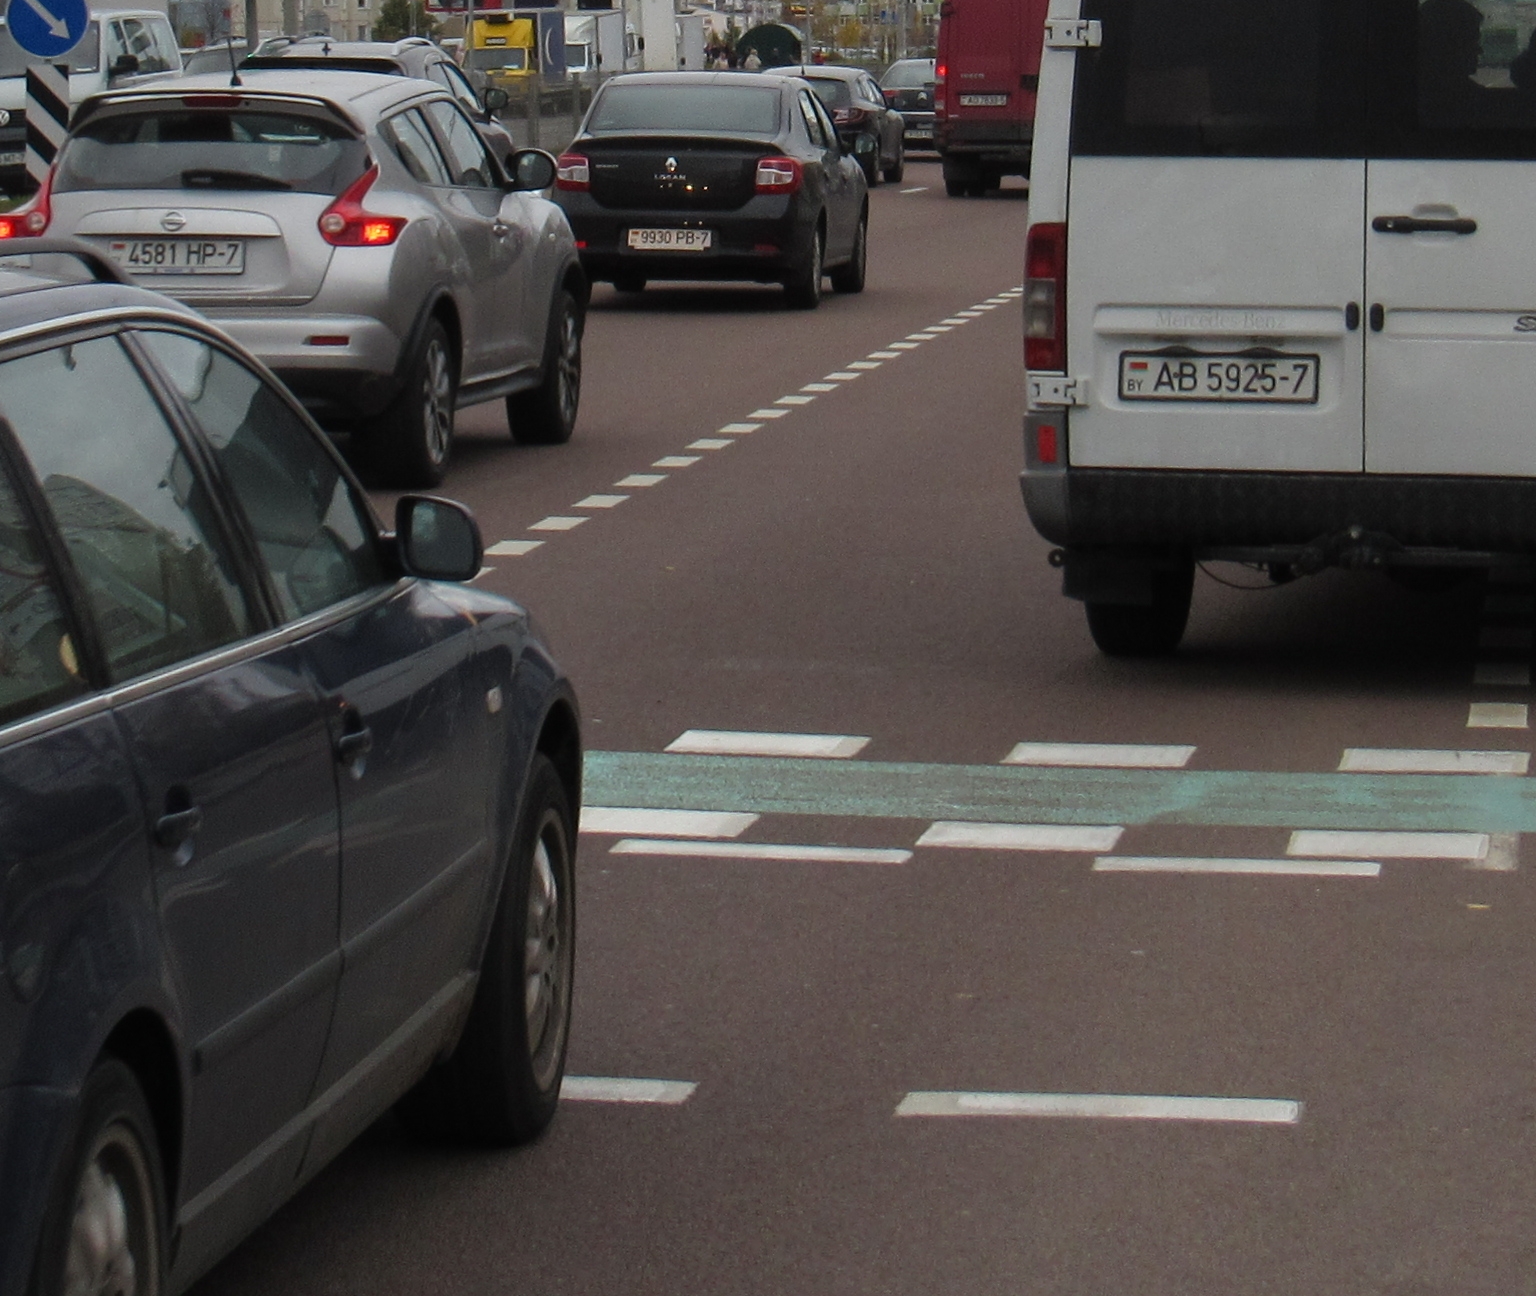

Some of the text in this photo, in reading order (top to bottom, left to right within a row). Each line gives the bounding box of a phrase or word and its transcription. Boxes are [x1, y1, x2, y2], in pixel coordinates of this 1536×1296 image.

[640, 231, 672, 244] 9930
[128, 243, 177, 265] 4581
[186, 243, 239, 265] HP-7
[1127, 362, 1310, 394] BY AB 5925-7
